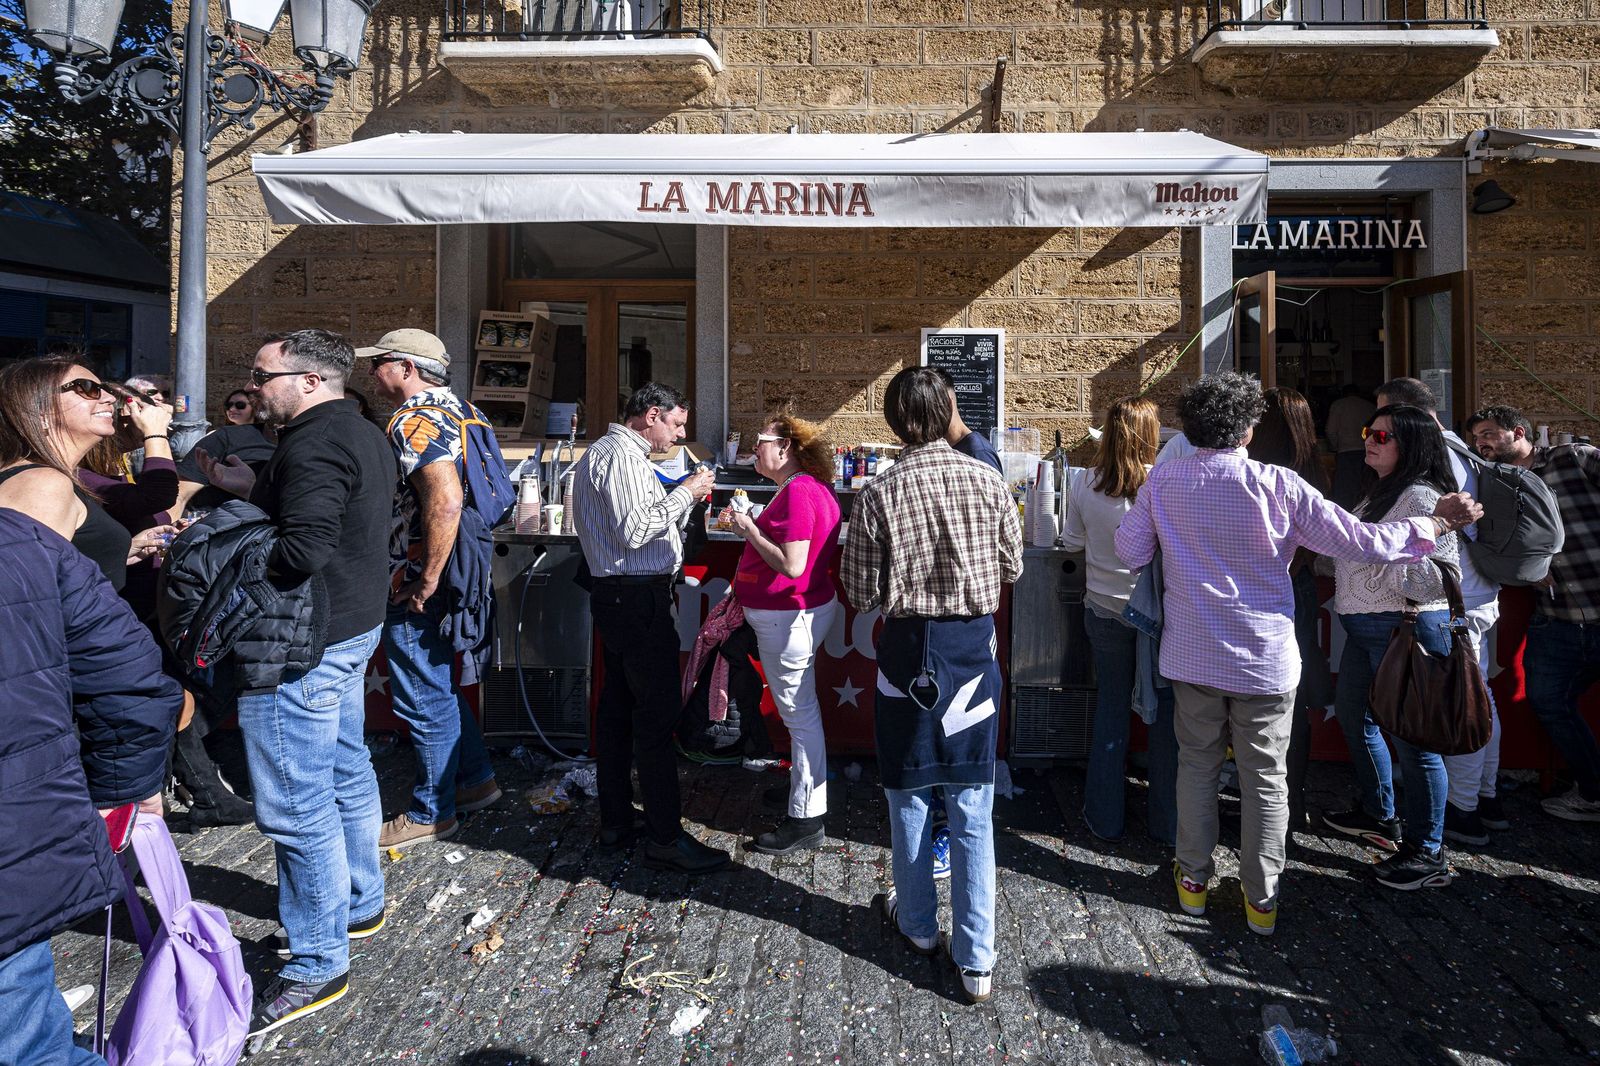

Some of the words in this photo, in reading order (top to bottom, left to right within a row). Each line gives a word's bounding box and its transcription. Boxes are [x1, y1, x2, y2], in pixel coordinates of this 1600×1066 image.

[637, 181, 689, 213] LA
[705, 181, 875, 216] MARINA
[1155, 182, 1239, 203] Mahou
[1231, 222, 1274, 250] LA
[1279, 219, 1428, 250] MARINA
